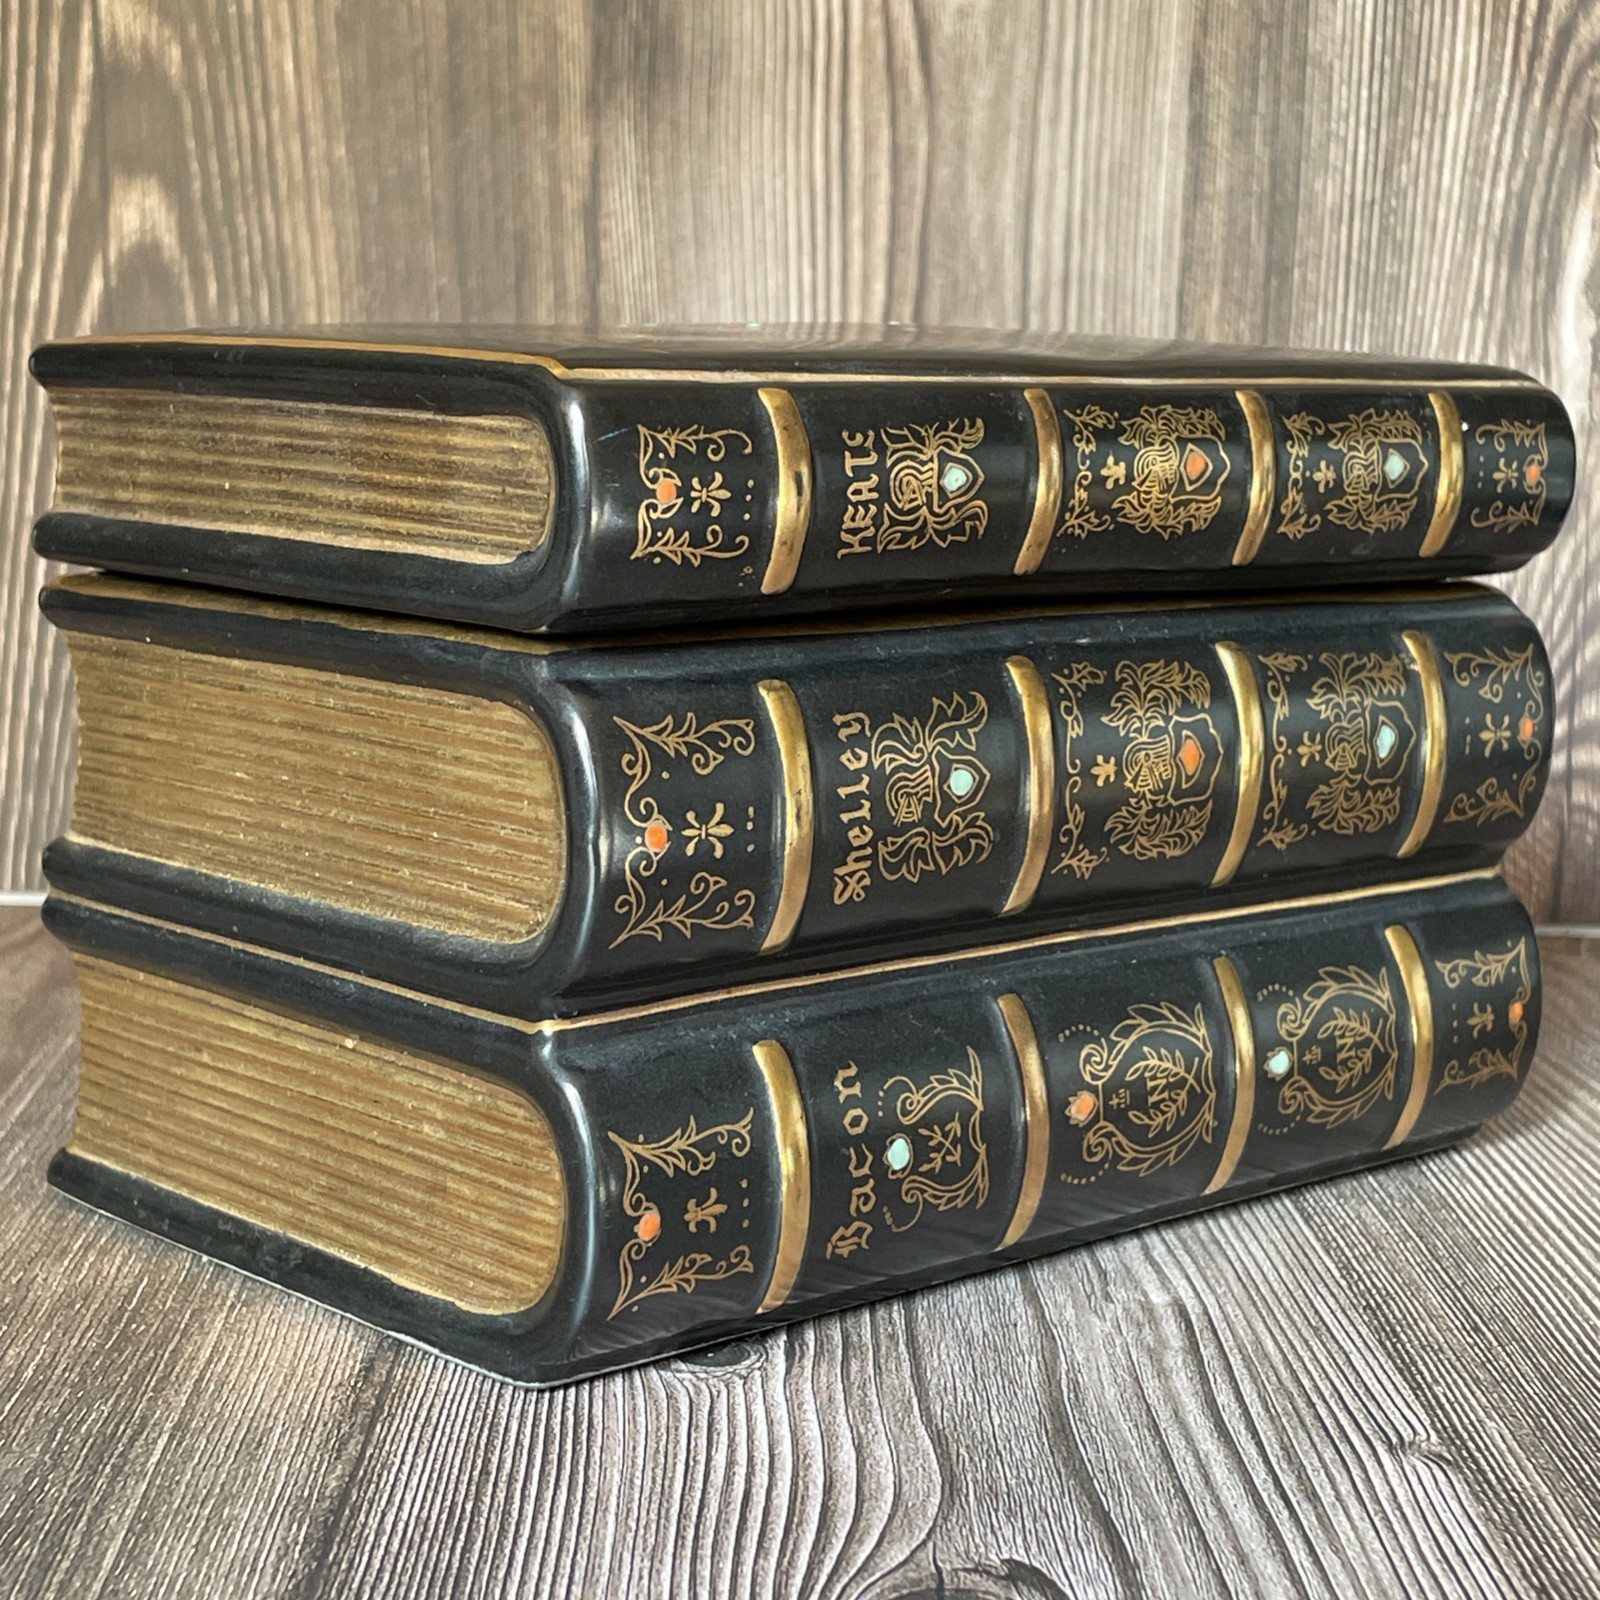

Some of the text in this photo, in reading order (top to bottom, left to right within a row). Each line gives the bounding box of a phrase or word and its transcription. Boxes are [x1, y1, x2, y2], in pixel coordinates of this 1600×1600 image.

[836, 429, 879, 560] KEATS
[832, 712, 874, 905] Shelley
[825, 1060, 877, 1259] Bacon
